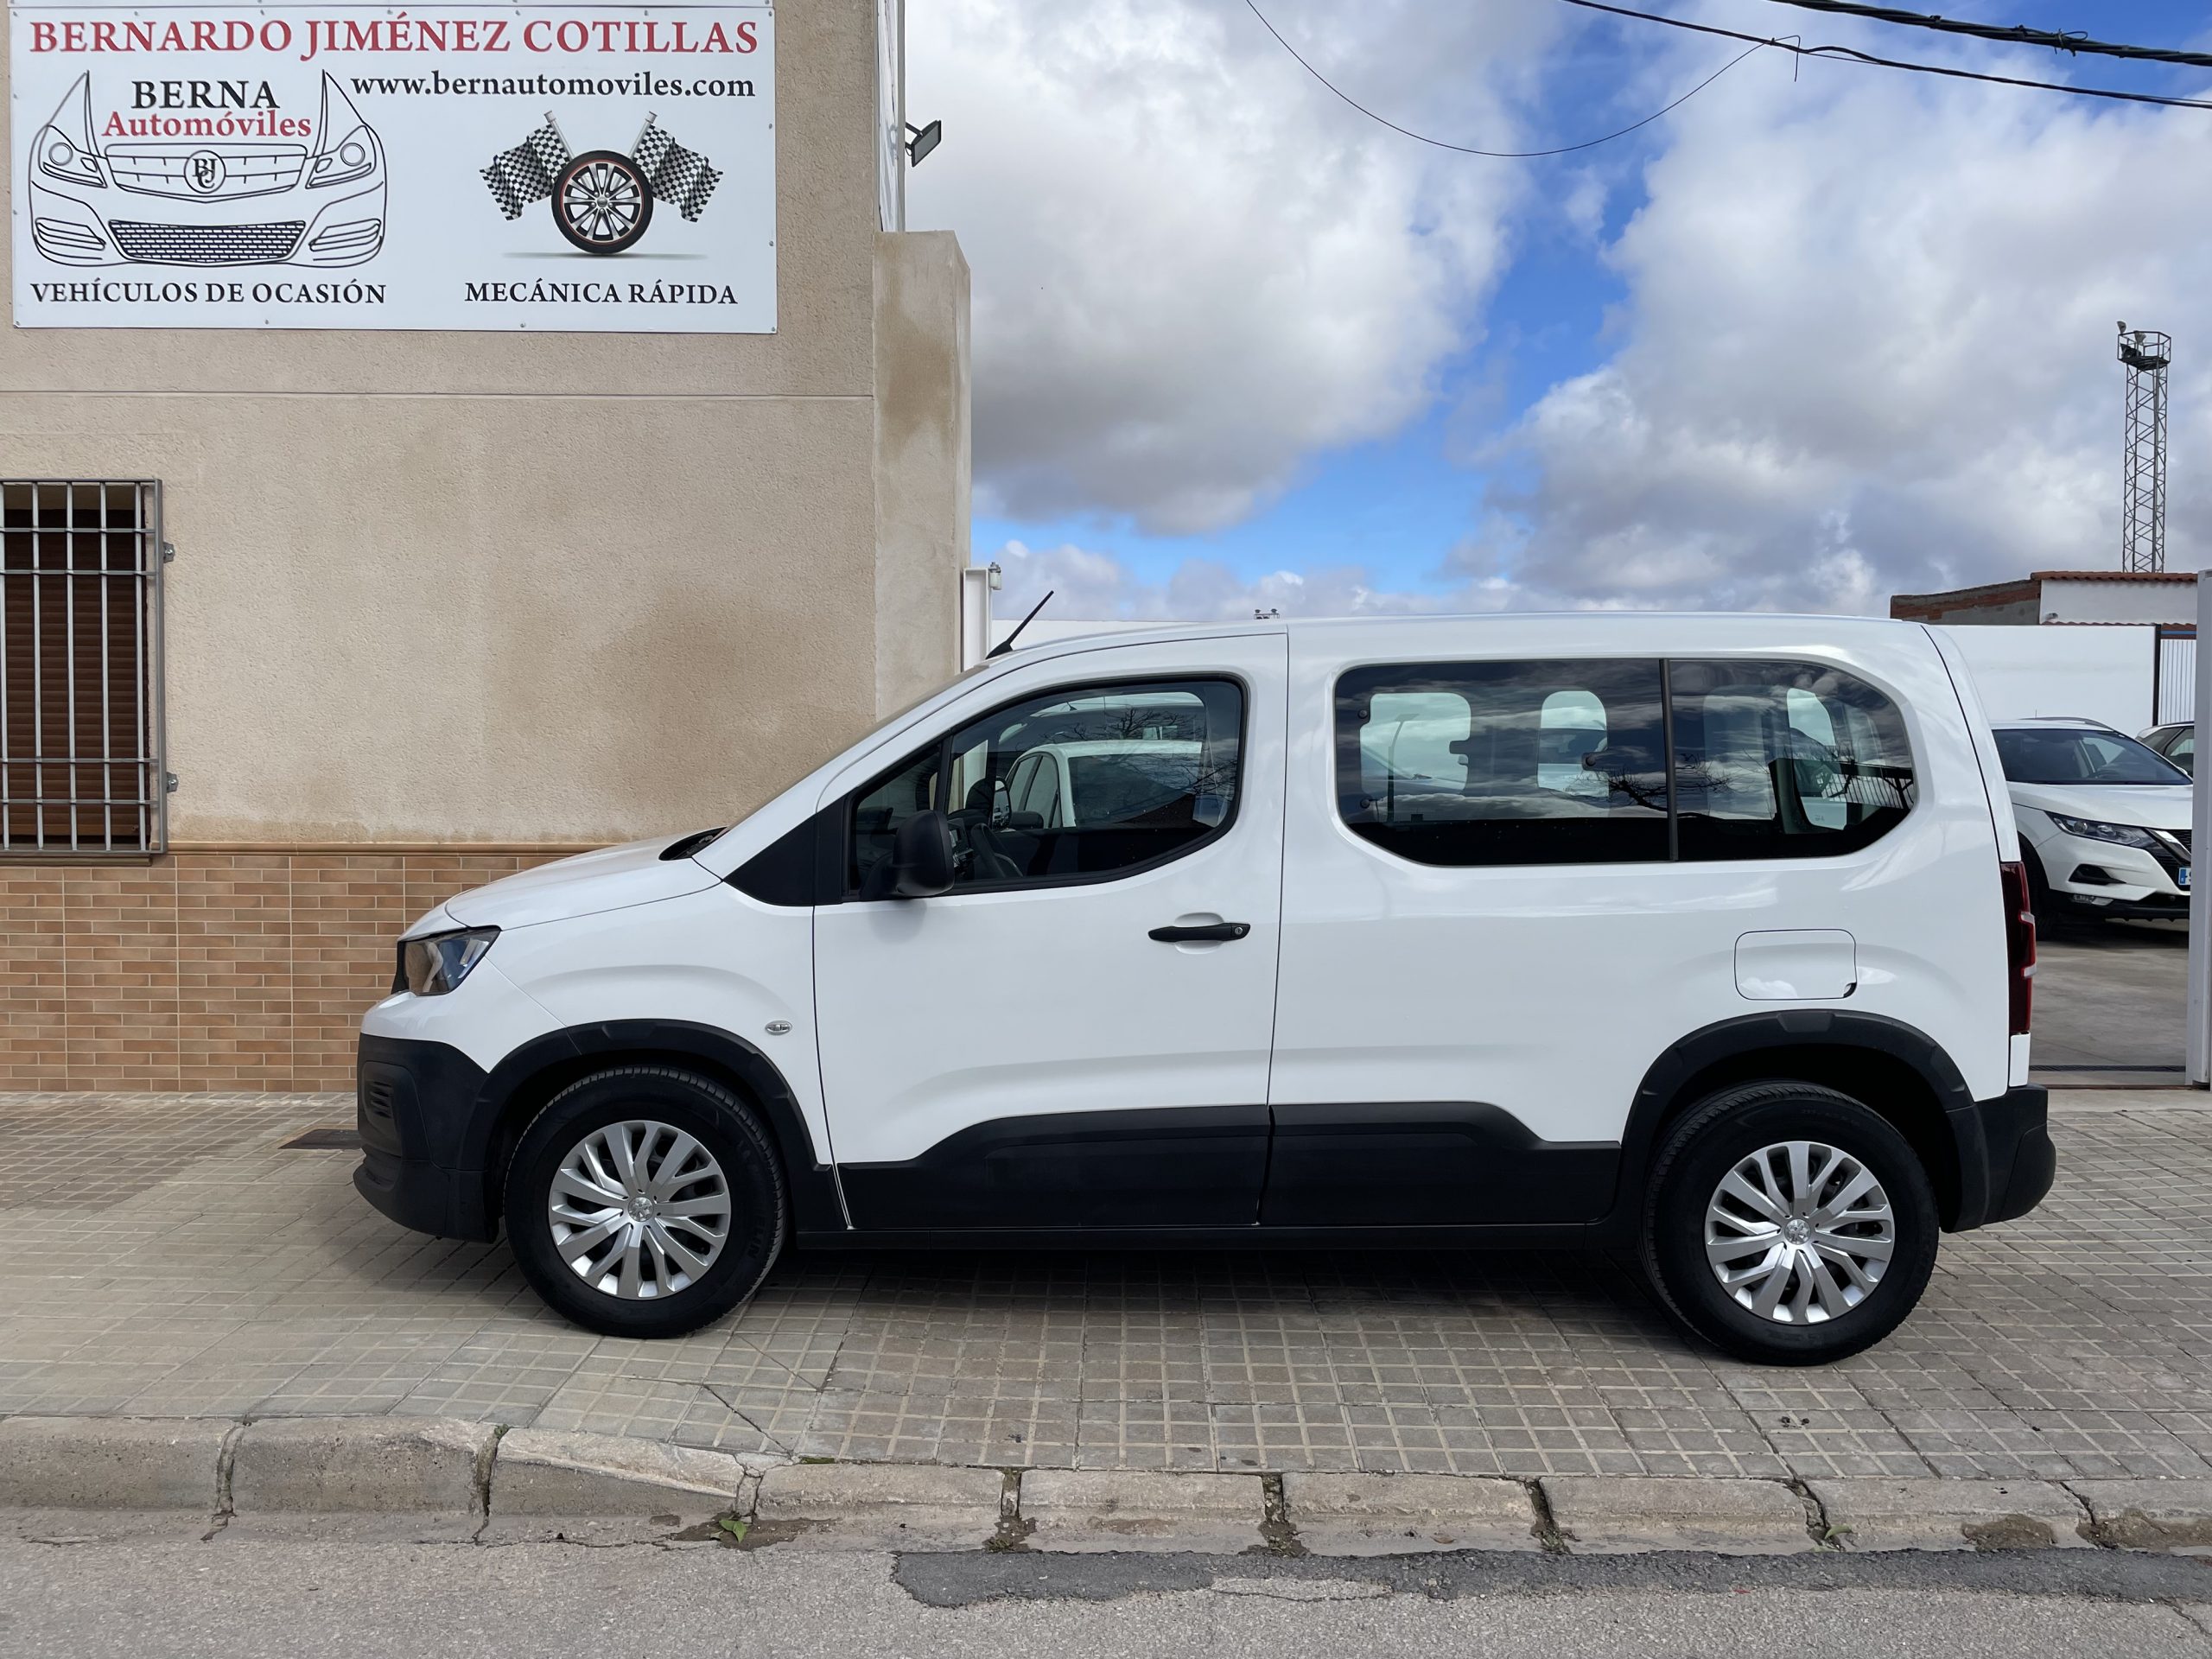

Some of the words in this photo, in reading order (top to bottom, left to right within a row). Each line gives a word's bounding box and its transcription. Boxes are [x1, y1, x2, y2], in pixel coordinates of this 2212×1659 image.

[30, 20, 292, 52] BERNARDO
[300, 12, 512, 61] JIMÉNEZ
[523, 21, 758, 54] COTILLAS
[131, 80, 281, 109] BERNA
[350, 70, 756, 98] www.bernautomoviles.com
[101, 110, 312, 137] Automóviles
[30, 276, 198, 303] VEHÍCULOS
[206, 283, 245, 302] DE
[251, 276, 387, 304] OCASIÓN
[464, 278, 623, 303] MECÁNICA
[628, 278, 739, 305] RÁPIDA
